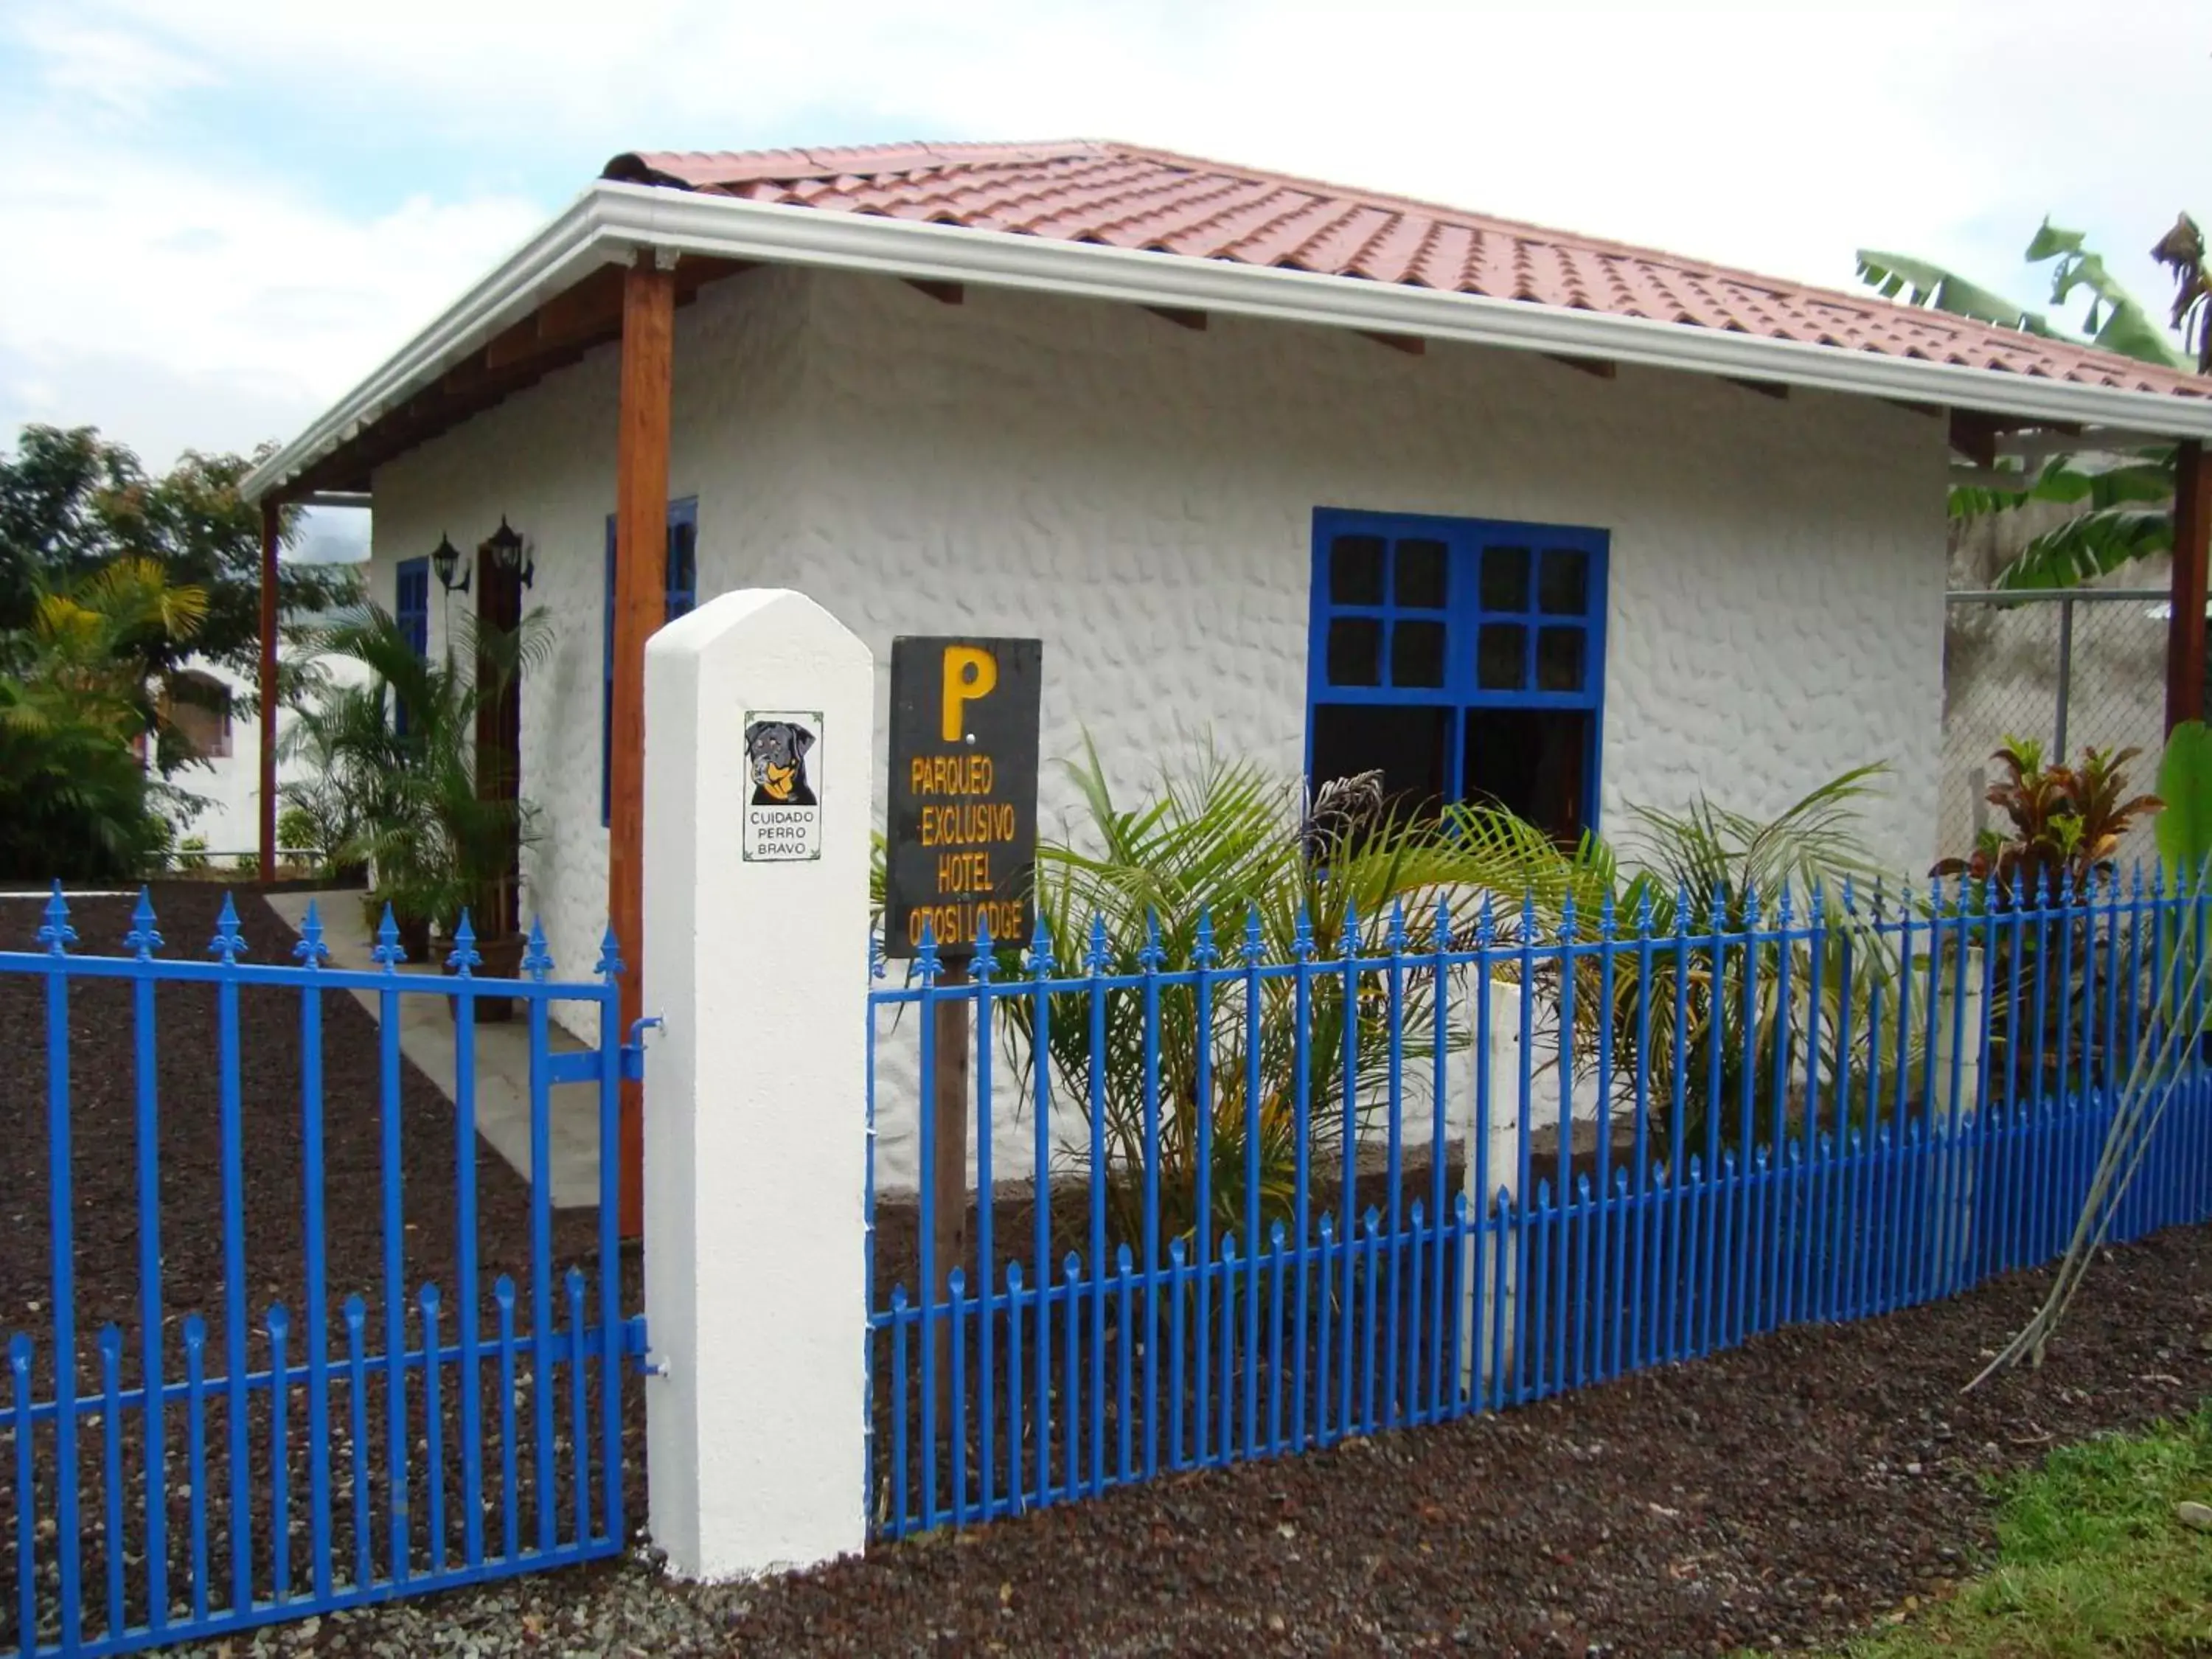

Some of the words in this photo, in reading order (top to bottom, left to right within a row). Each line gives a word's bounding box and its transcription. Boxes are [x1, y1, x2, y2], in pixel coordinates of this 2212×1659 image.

[942, 645, 998, 742] P
[911, 754, 993, 796] PARQUEO
[750, 812, 814, 825] CUIDADO
[758, 827, 806, 839] PERRO
[922, 804, 1015, 846] EXCLUSIVO
[757, 843, 806, 855] BRAVO
[938, 852, 993, 894] HOTEL
